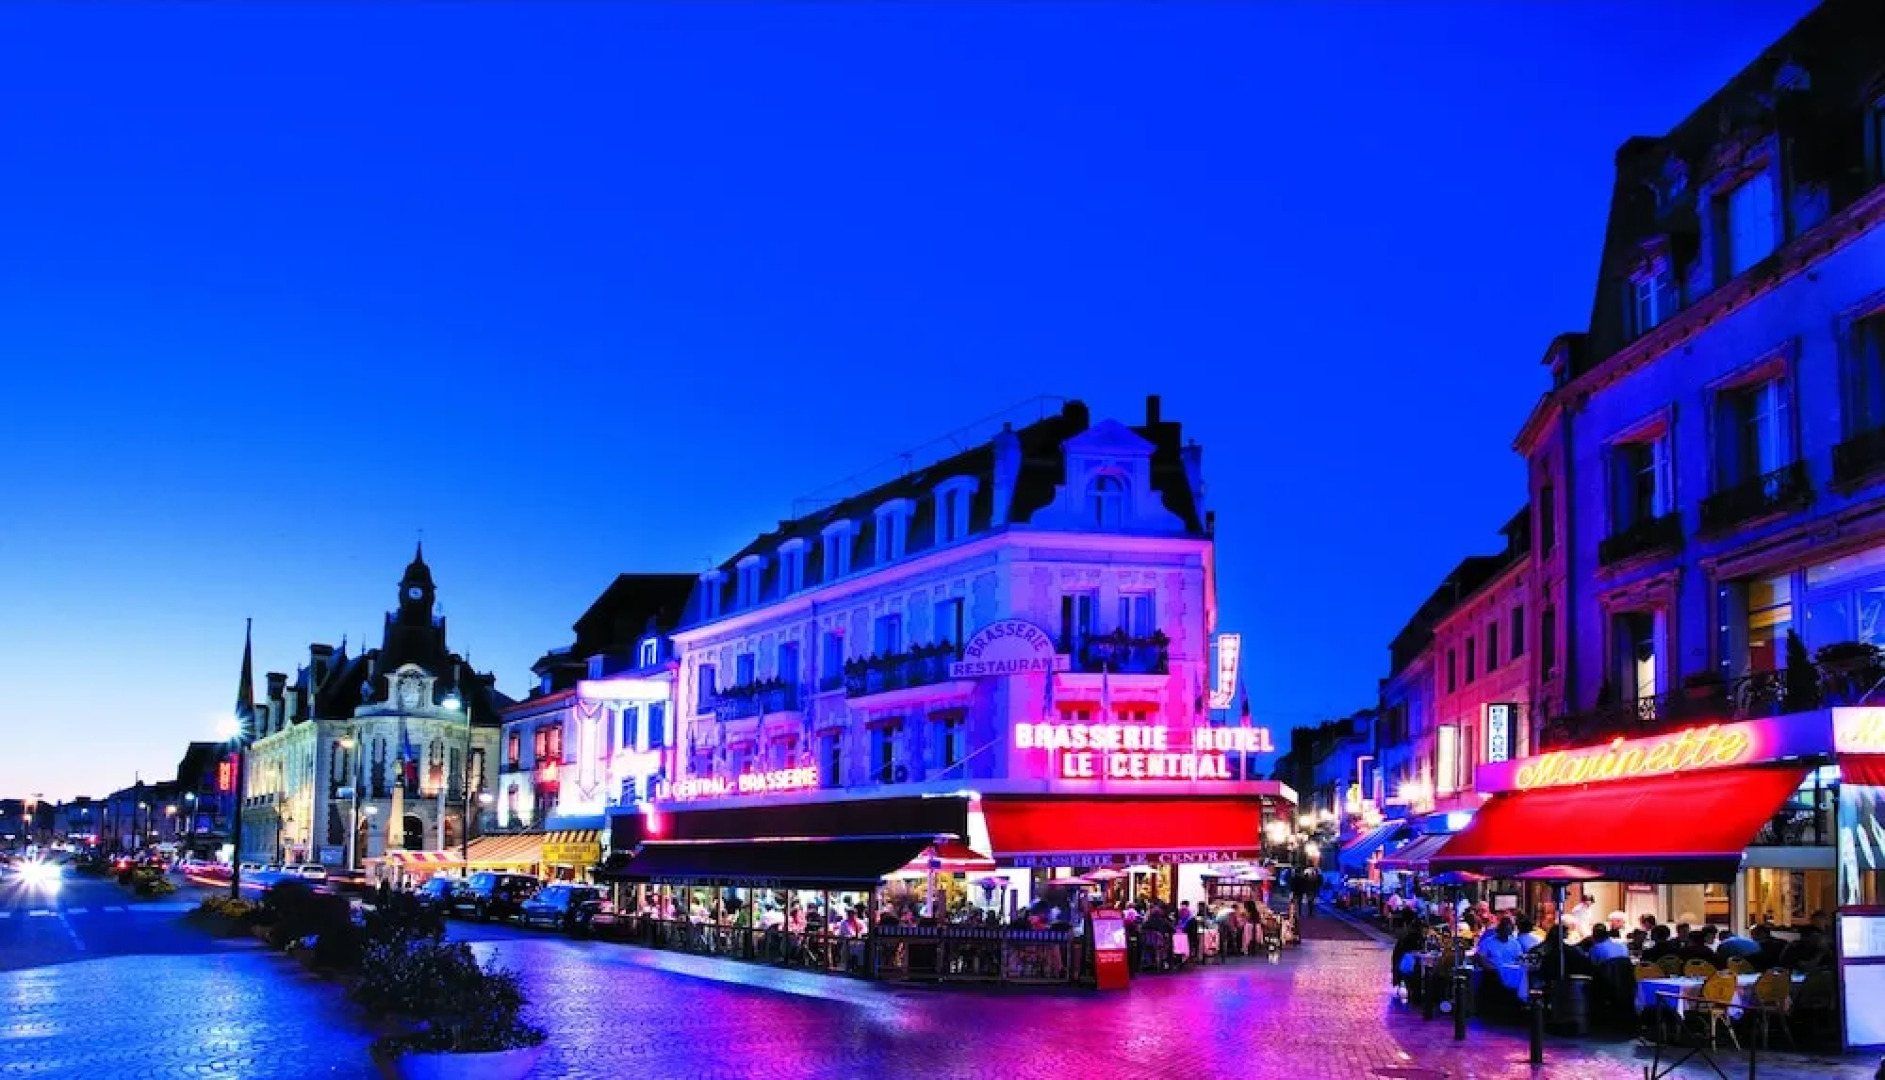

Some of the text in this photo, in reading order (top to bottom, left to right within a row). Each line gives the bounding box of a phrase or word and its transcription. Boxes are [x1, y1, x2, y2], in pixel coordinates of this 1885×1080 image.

[966, 623, 1048, 658] BRASSERIE
[953, 657, 1064, 675] RESTAURANT
[1015, 723, 1274, 752] BRASSERIE HOTEL
[1062, 752, 1231, 778] LE CENTRAL
[1517, 724, 1749, 788] Marinette
[738, 766, 818, 791] BRASSERIE
[1013, 851, 1242, 867] BRASSERIE LE CENTRAL
